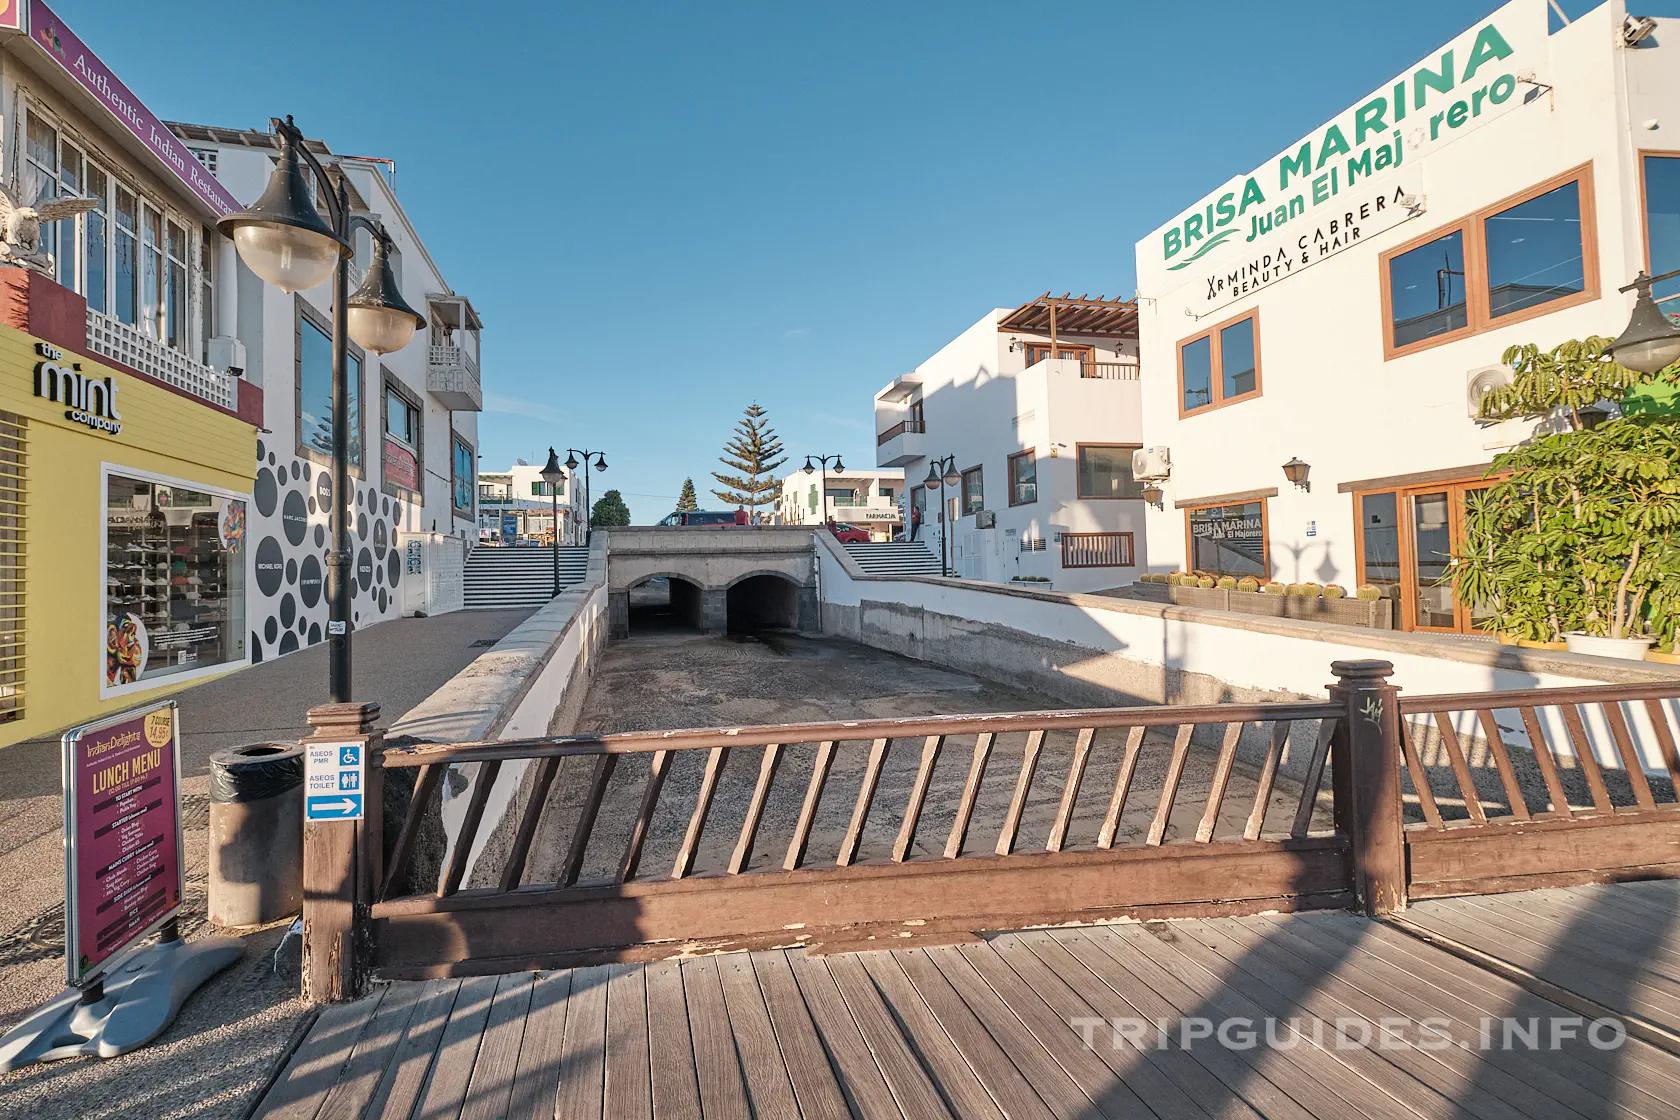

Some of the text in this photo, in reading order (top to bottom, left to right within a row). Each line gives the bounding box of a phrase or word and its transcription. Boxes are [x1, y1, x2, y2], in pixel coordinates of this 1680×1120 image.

[73, 54, 236, 214] Authentic Indian Restauran
[1163, 23, 1515, 261] BRISA MARINA
[1246, 193, 1305, 243] Juan
[1311, 166, 1339, 206] El
[1298, 185, 1406, 249] CABRERA
[1233, 226, 1362, 297] BEAUTY & HAIR
[42, 342, 63, 360] the
[40, 361, 122, 421] mint
[71, 410, 123, 435] company
[1192, 518, 1262, 534] BRISA MARINA
[1228, 530, 1234, 538] El
[1235, 530, 1262, 539] Majorero
[151, 716, 156, 726] 7
[93, 760, 128, 794] LUNCH
[132, 749, 160, 777] MENU
